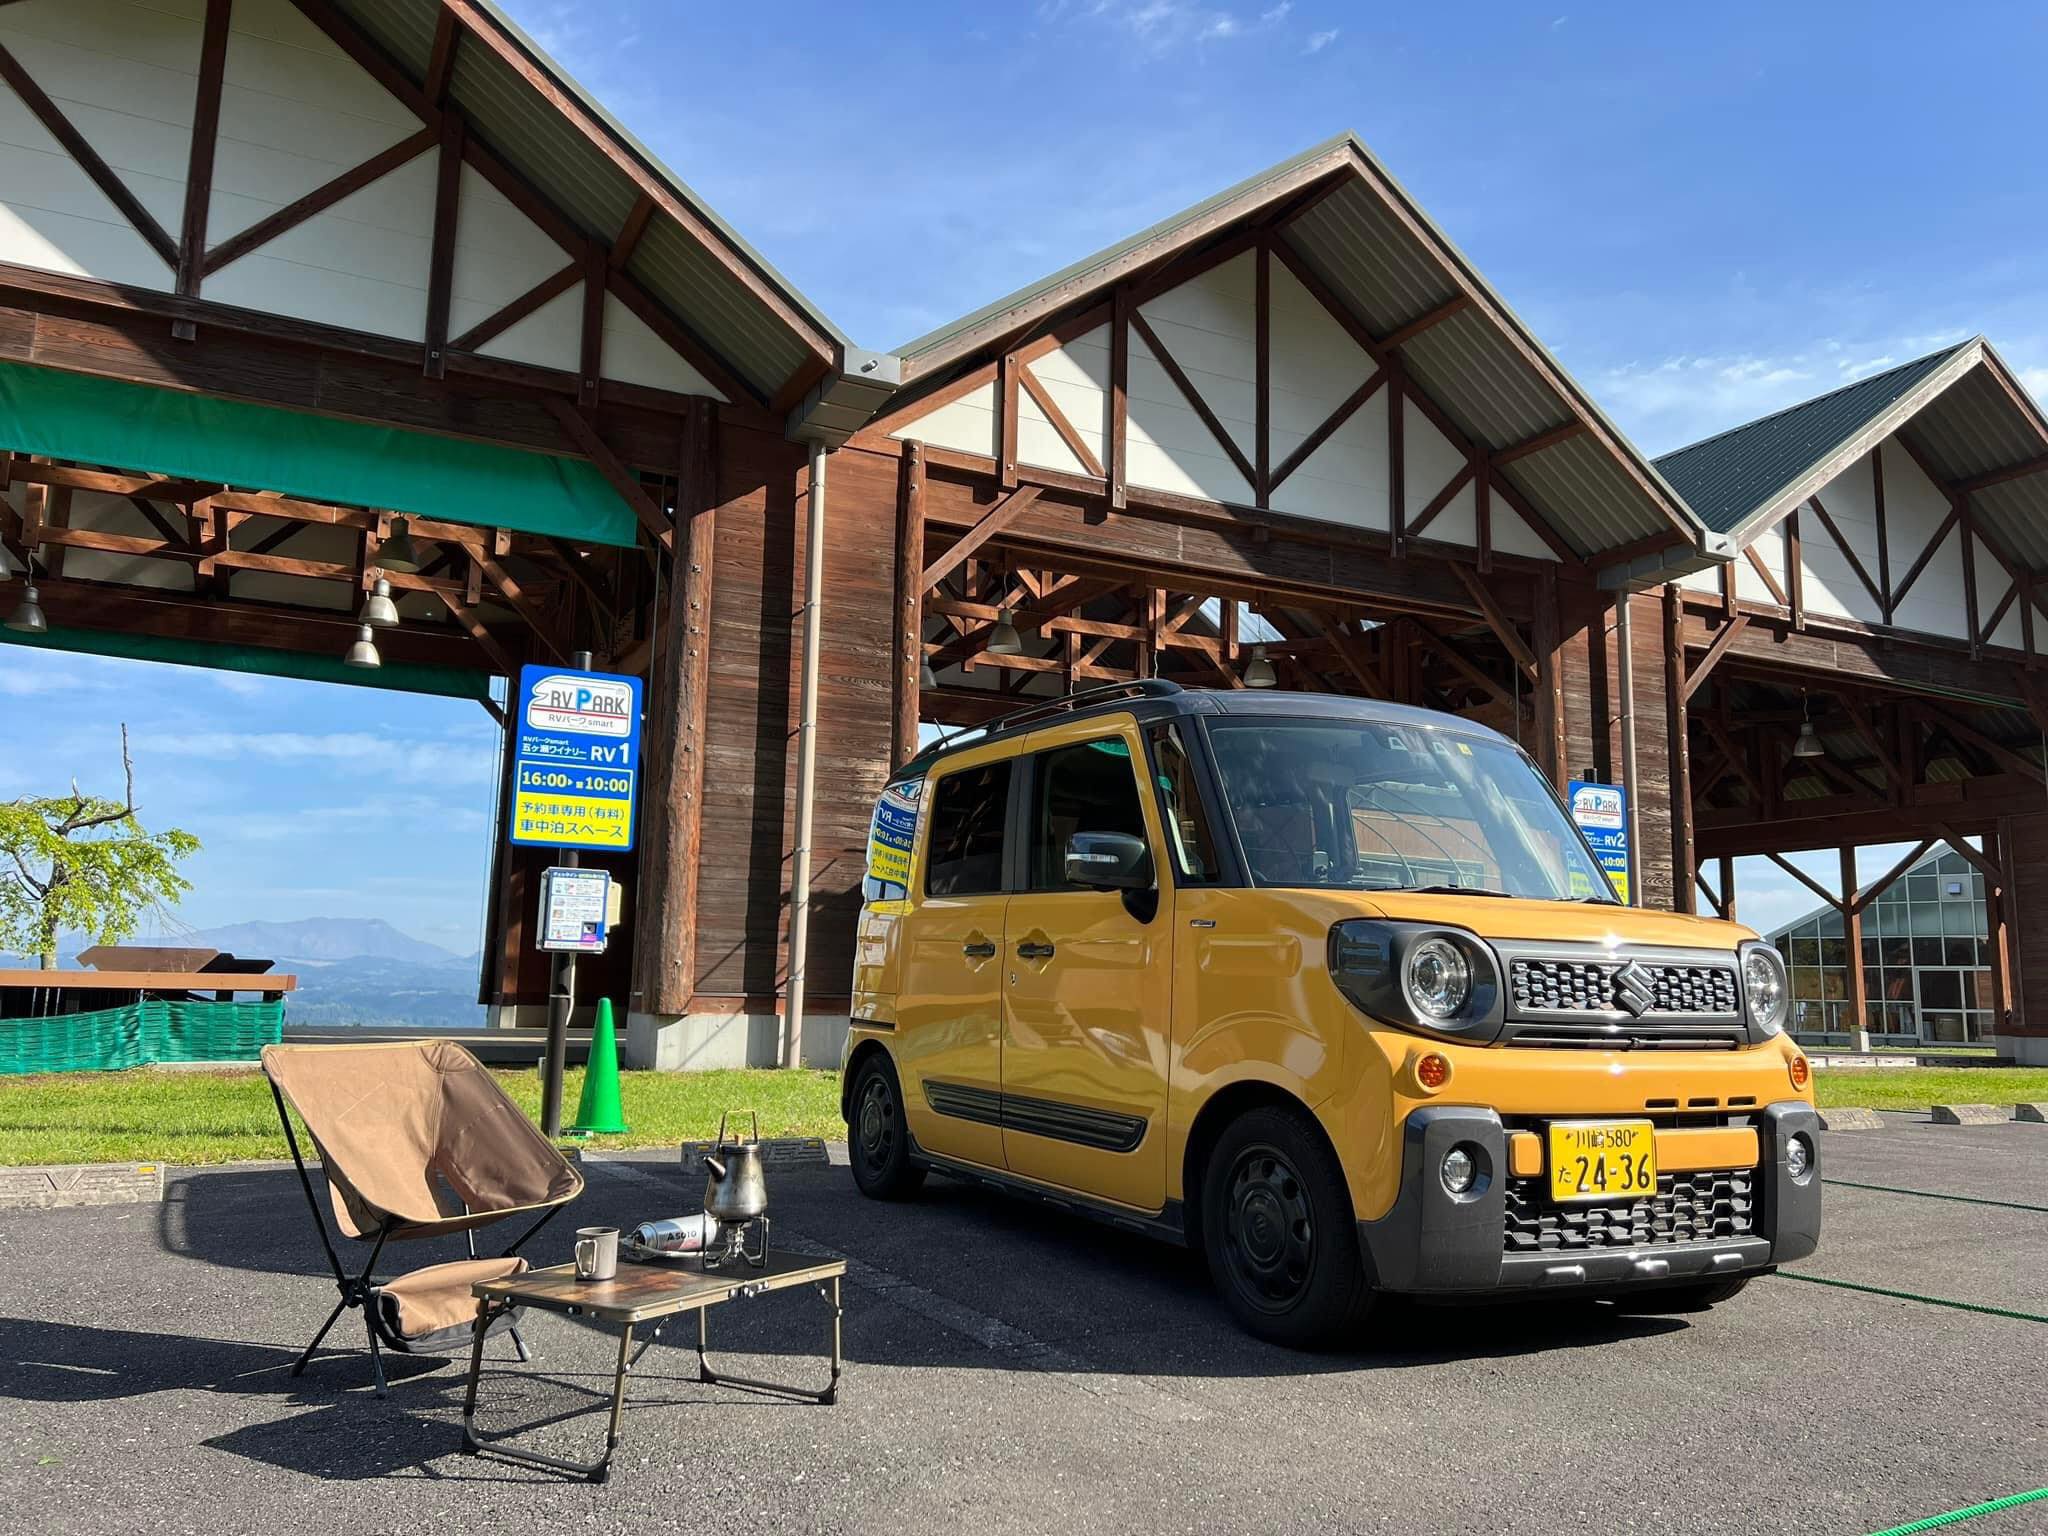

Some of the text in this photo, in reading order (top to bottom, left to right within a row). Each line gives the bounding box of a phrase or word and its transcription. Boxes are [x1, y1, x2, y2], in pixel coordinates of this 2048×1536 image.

[550, 687, 625, 714] RV PARK
[522, 771, 567, 788] 16:00
[1606, 1129, 1632, 1148] 580
[1558, 1153, 1650, 1193] た 24-36
